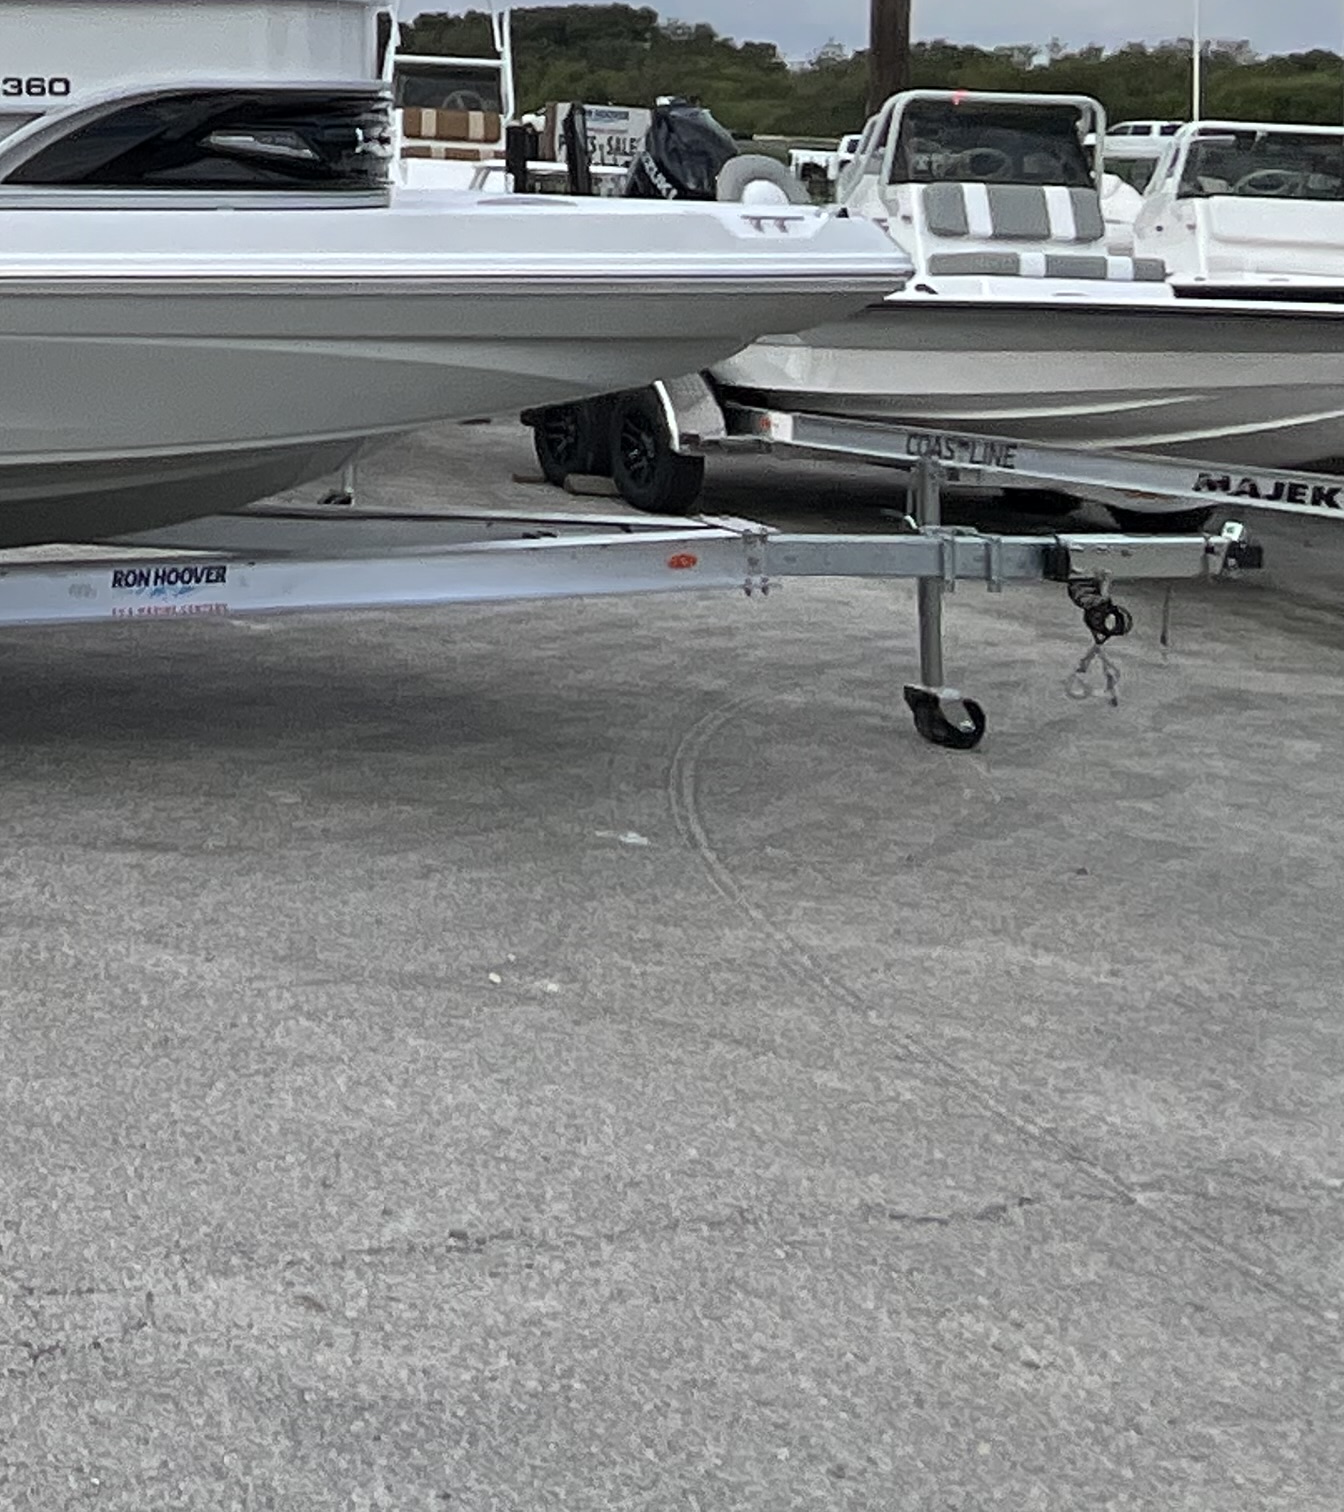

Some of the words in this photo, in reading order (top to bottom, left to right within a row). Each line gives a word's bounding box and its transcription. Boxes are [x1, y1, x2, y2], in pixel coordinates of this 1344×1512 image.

[1191, 472, 1344, 509] MAJEK
[111, 568, 151, 589] RON
[153, 564, 227, 587] HOOVER
